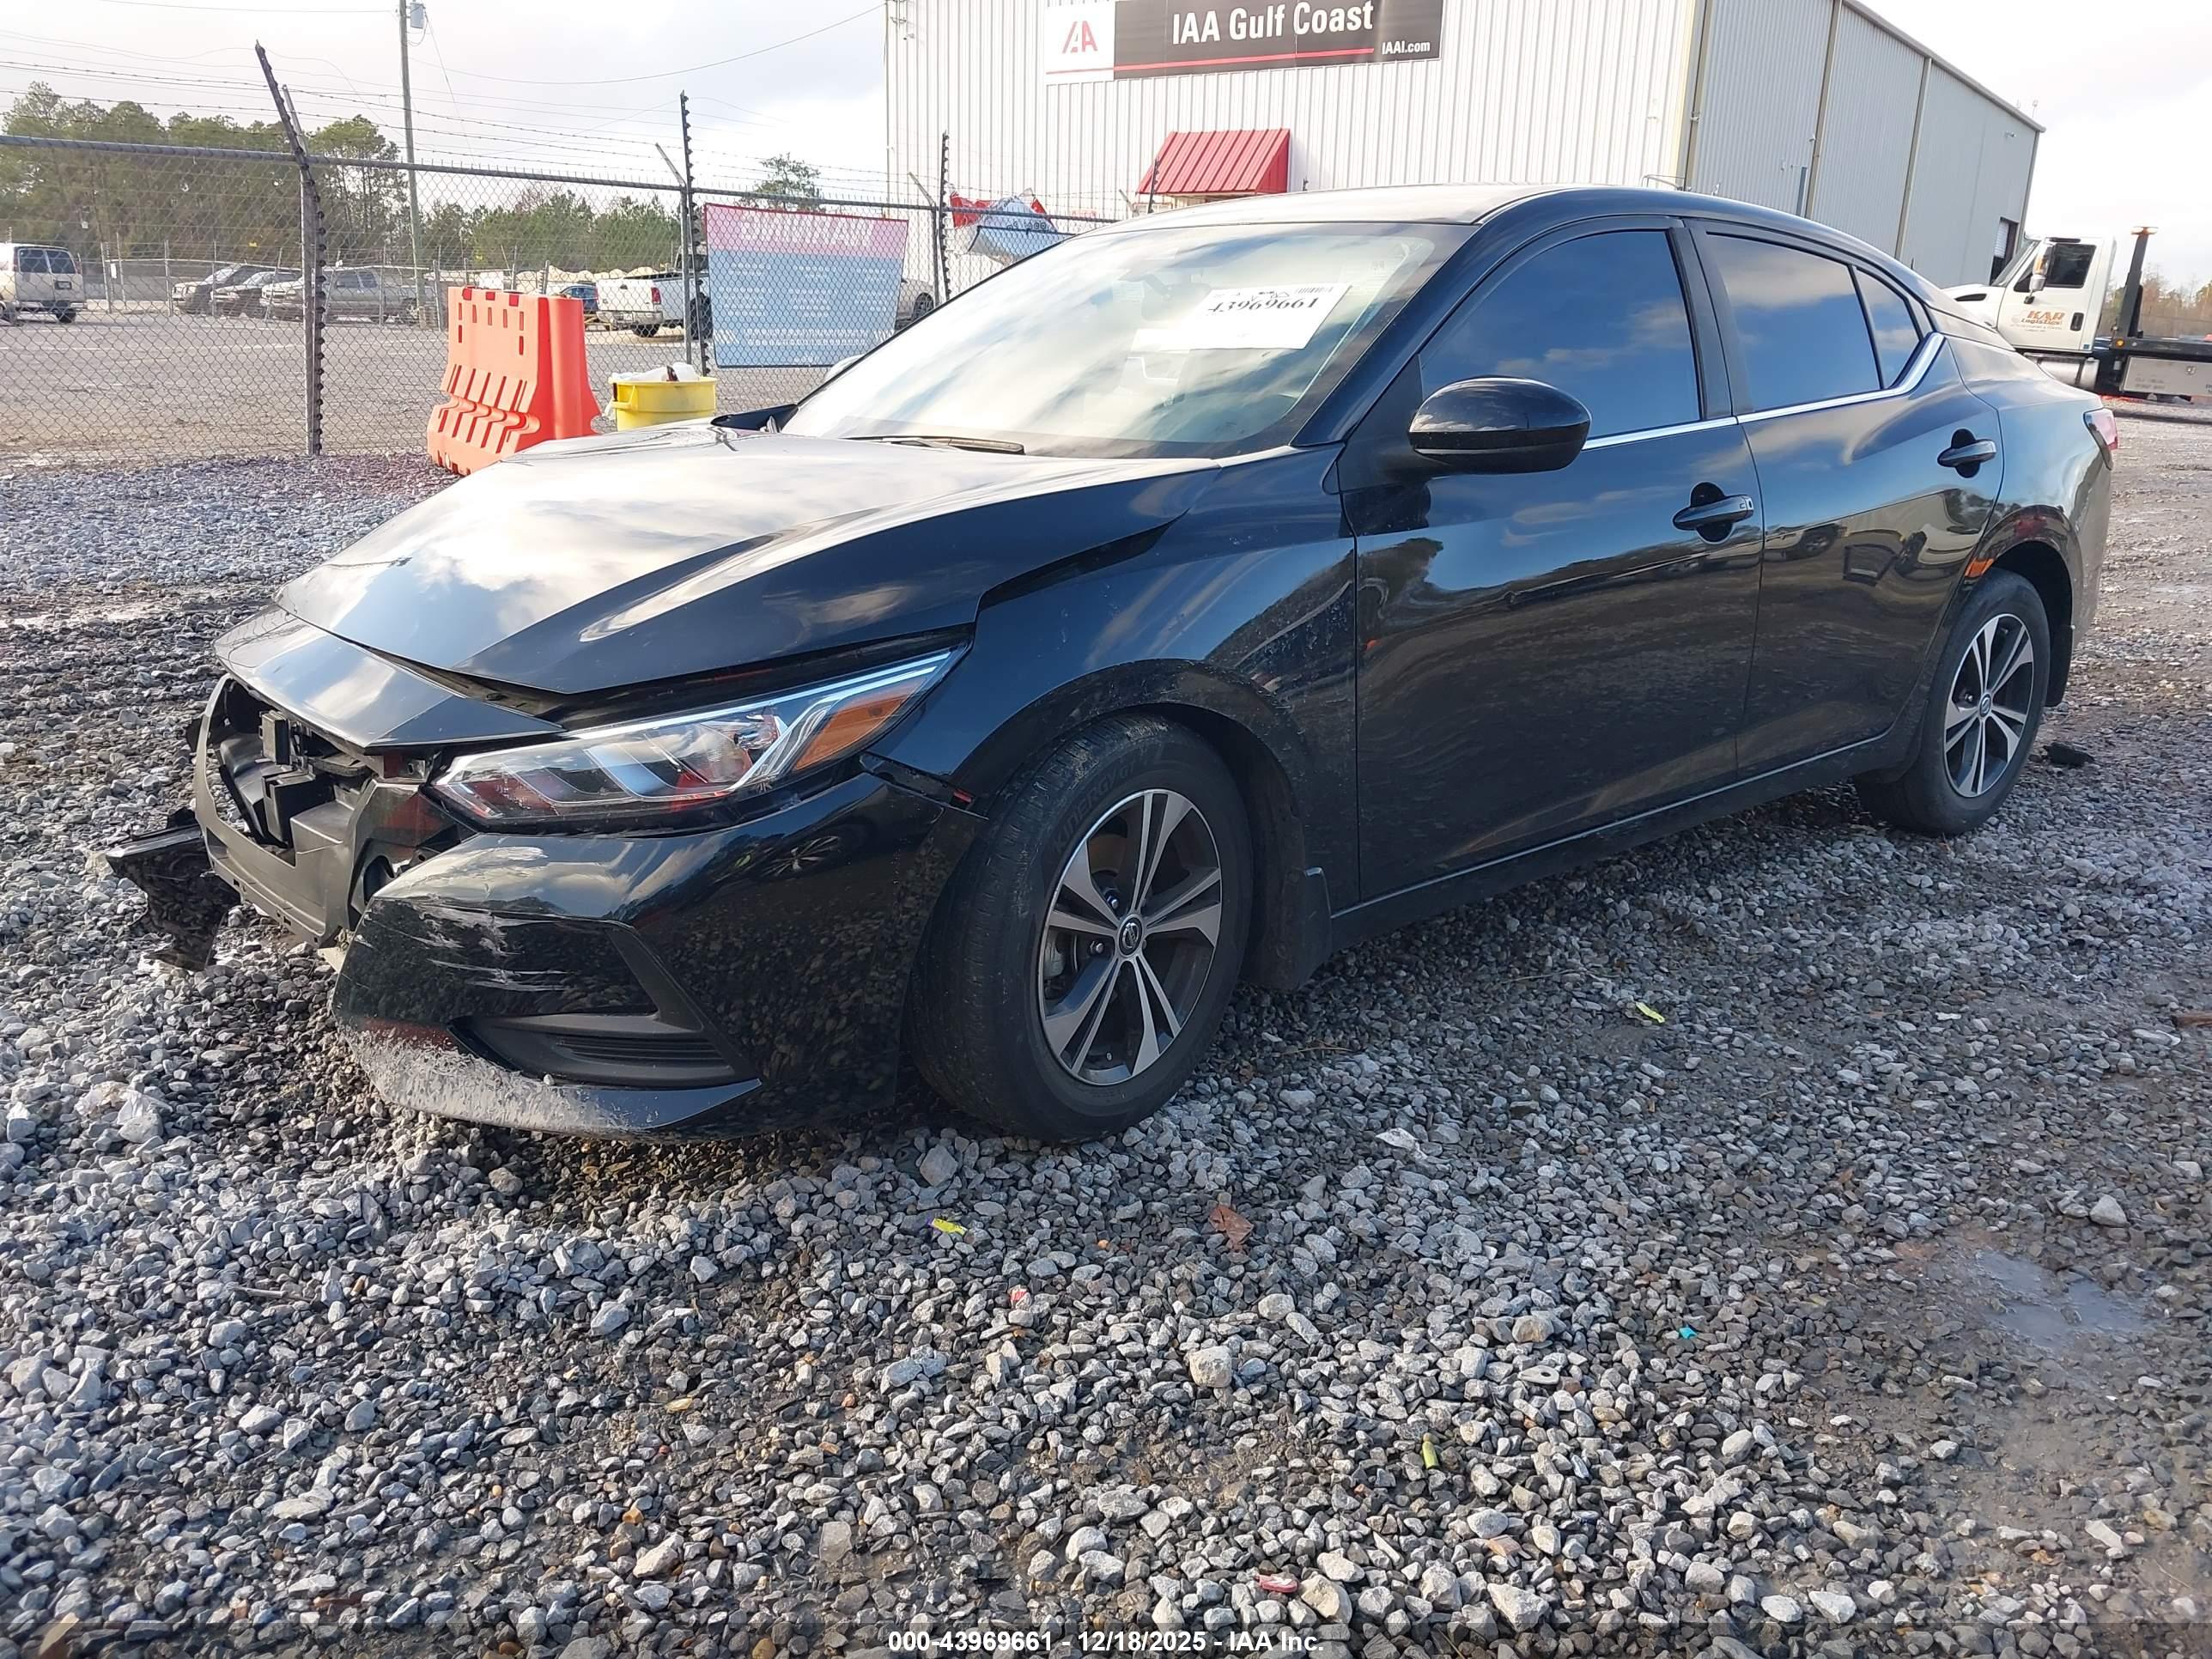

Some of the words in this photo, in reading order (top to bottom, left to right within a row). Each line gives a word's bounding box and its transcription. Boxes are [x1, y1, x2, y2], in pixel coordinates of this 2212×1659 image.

[1173, 10, 1221, 45] IAA
[1229, 3, 1285, 40] Gulf
[1293, 1, 1374, 35] Coast
[1206, 296, 1320, 313] 43969661
